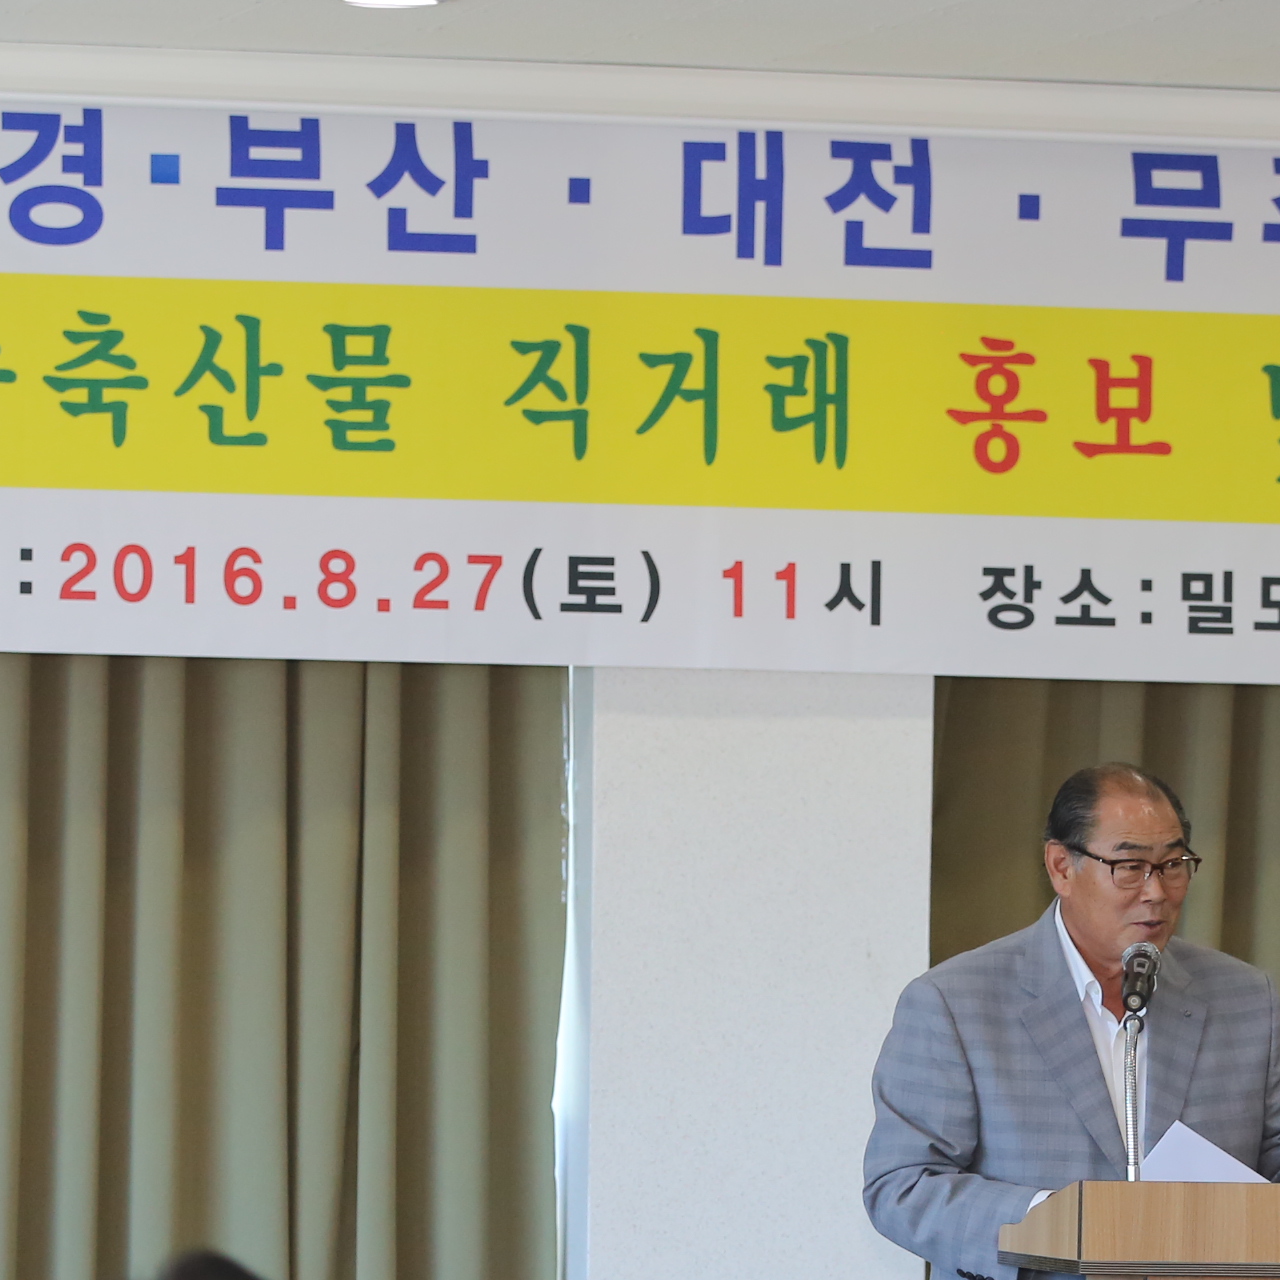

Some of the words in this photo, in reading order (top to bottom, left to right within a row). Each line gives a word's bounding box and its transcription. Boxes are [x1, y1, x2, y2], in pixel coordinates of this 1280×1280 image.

[681, 130, 933, 269] 대전
[504, 323, 850, 470] 직거래
[946, 336, 1172, 474] 홍보
[721, 560, 883, 627] 11시
